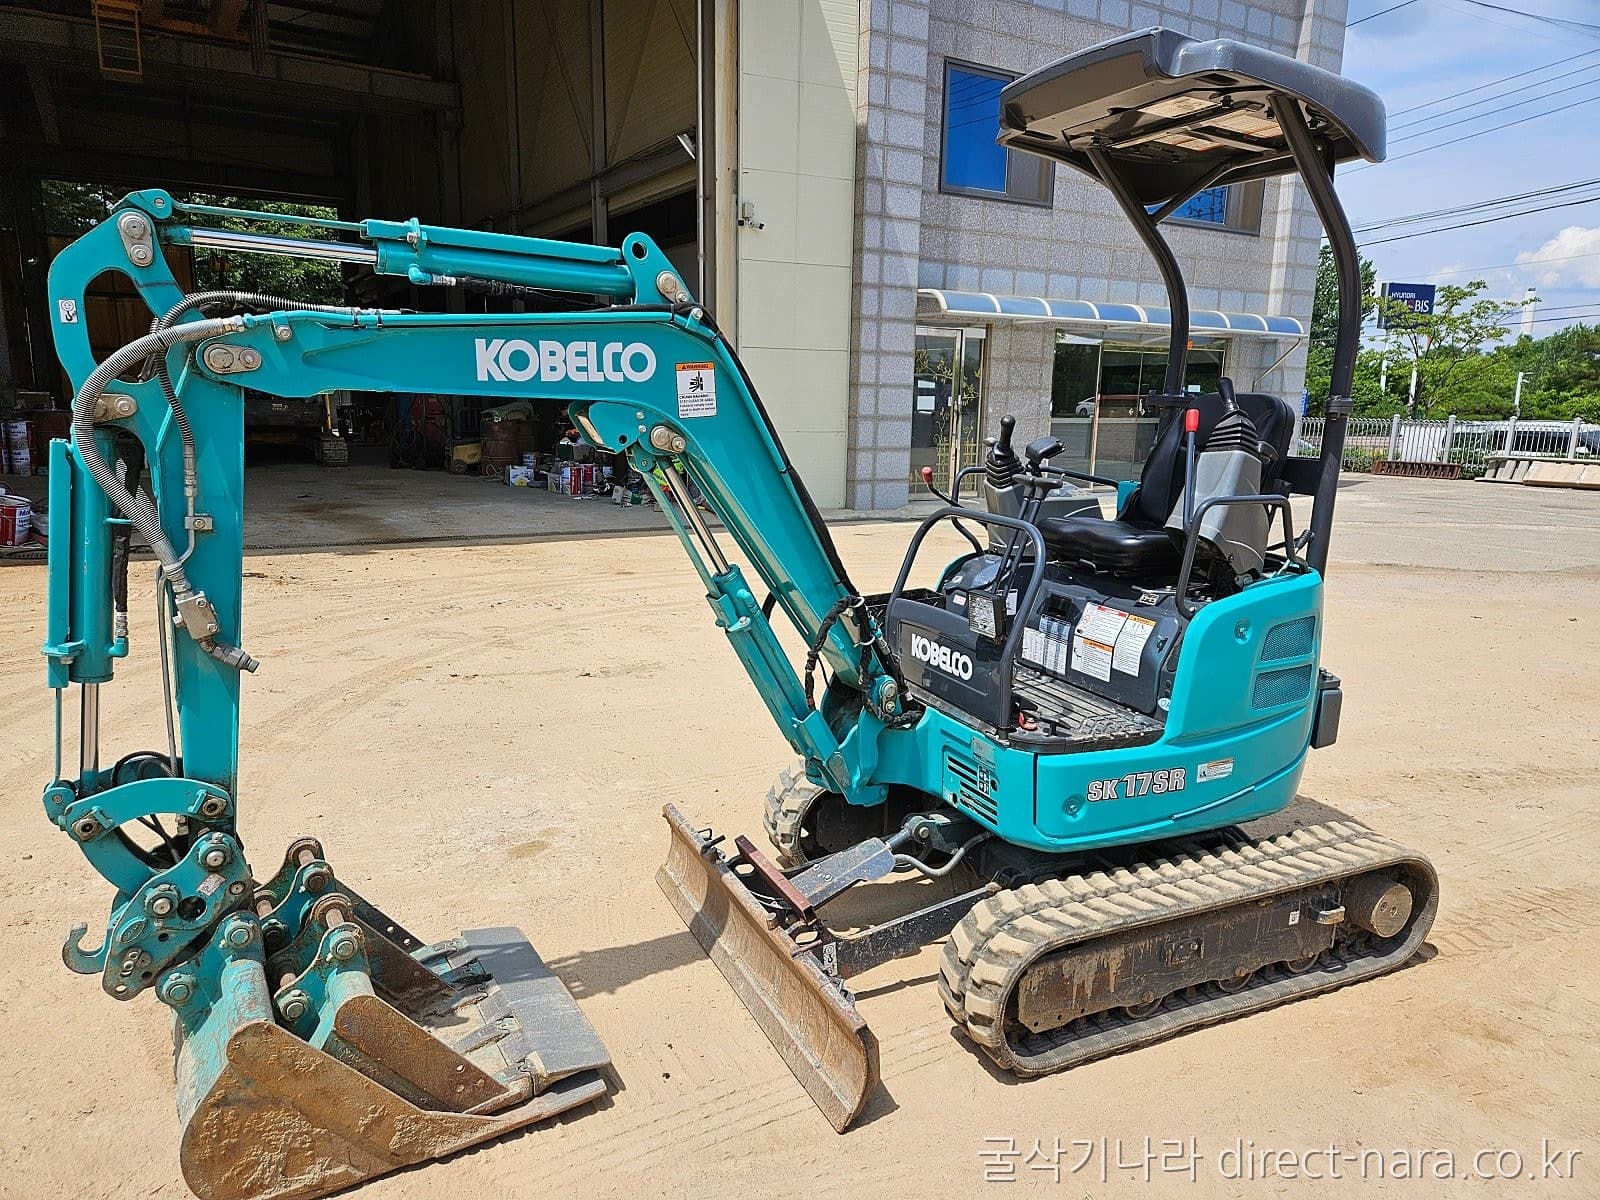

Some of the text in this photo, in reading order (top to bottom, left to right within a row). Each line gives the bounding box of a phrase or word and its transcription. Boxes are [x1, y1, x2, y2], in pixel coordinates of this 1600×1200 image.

[1391, 291, 1416, 299] HYUNDAI
[474, 338, 657, 383] KOBELCO
[911, 633, 973, 680] KOBELCO
